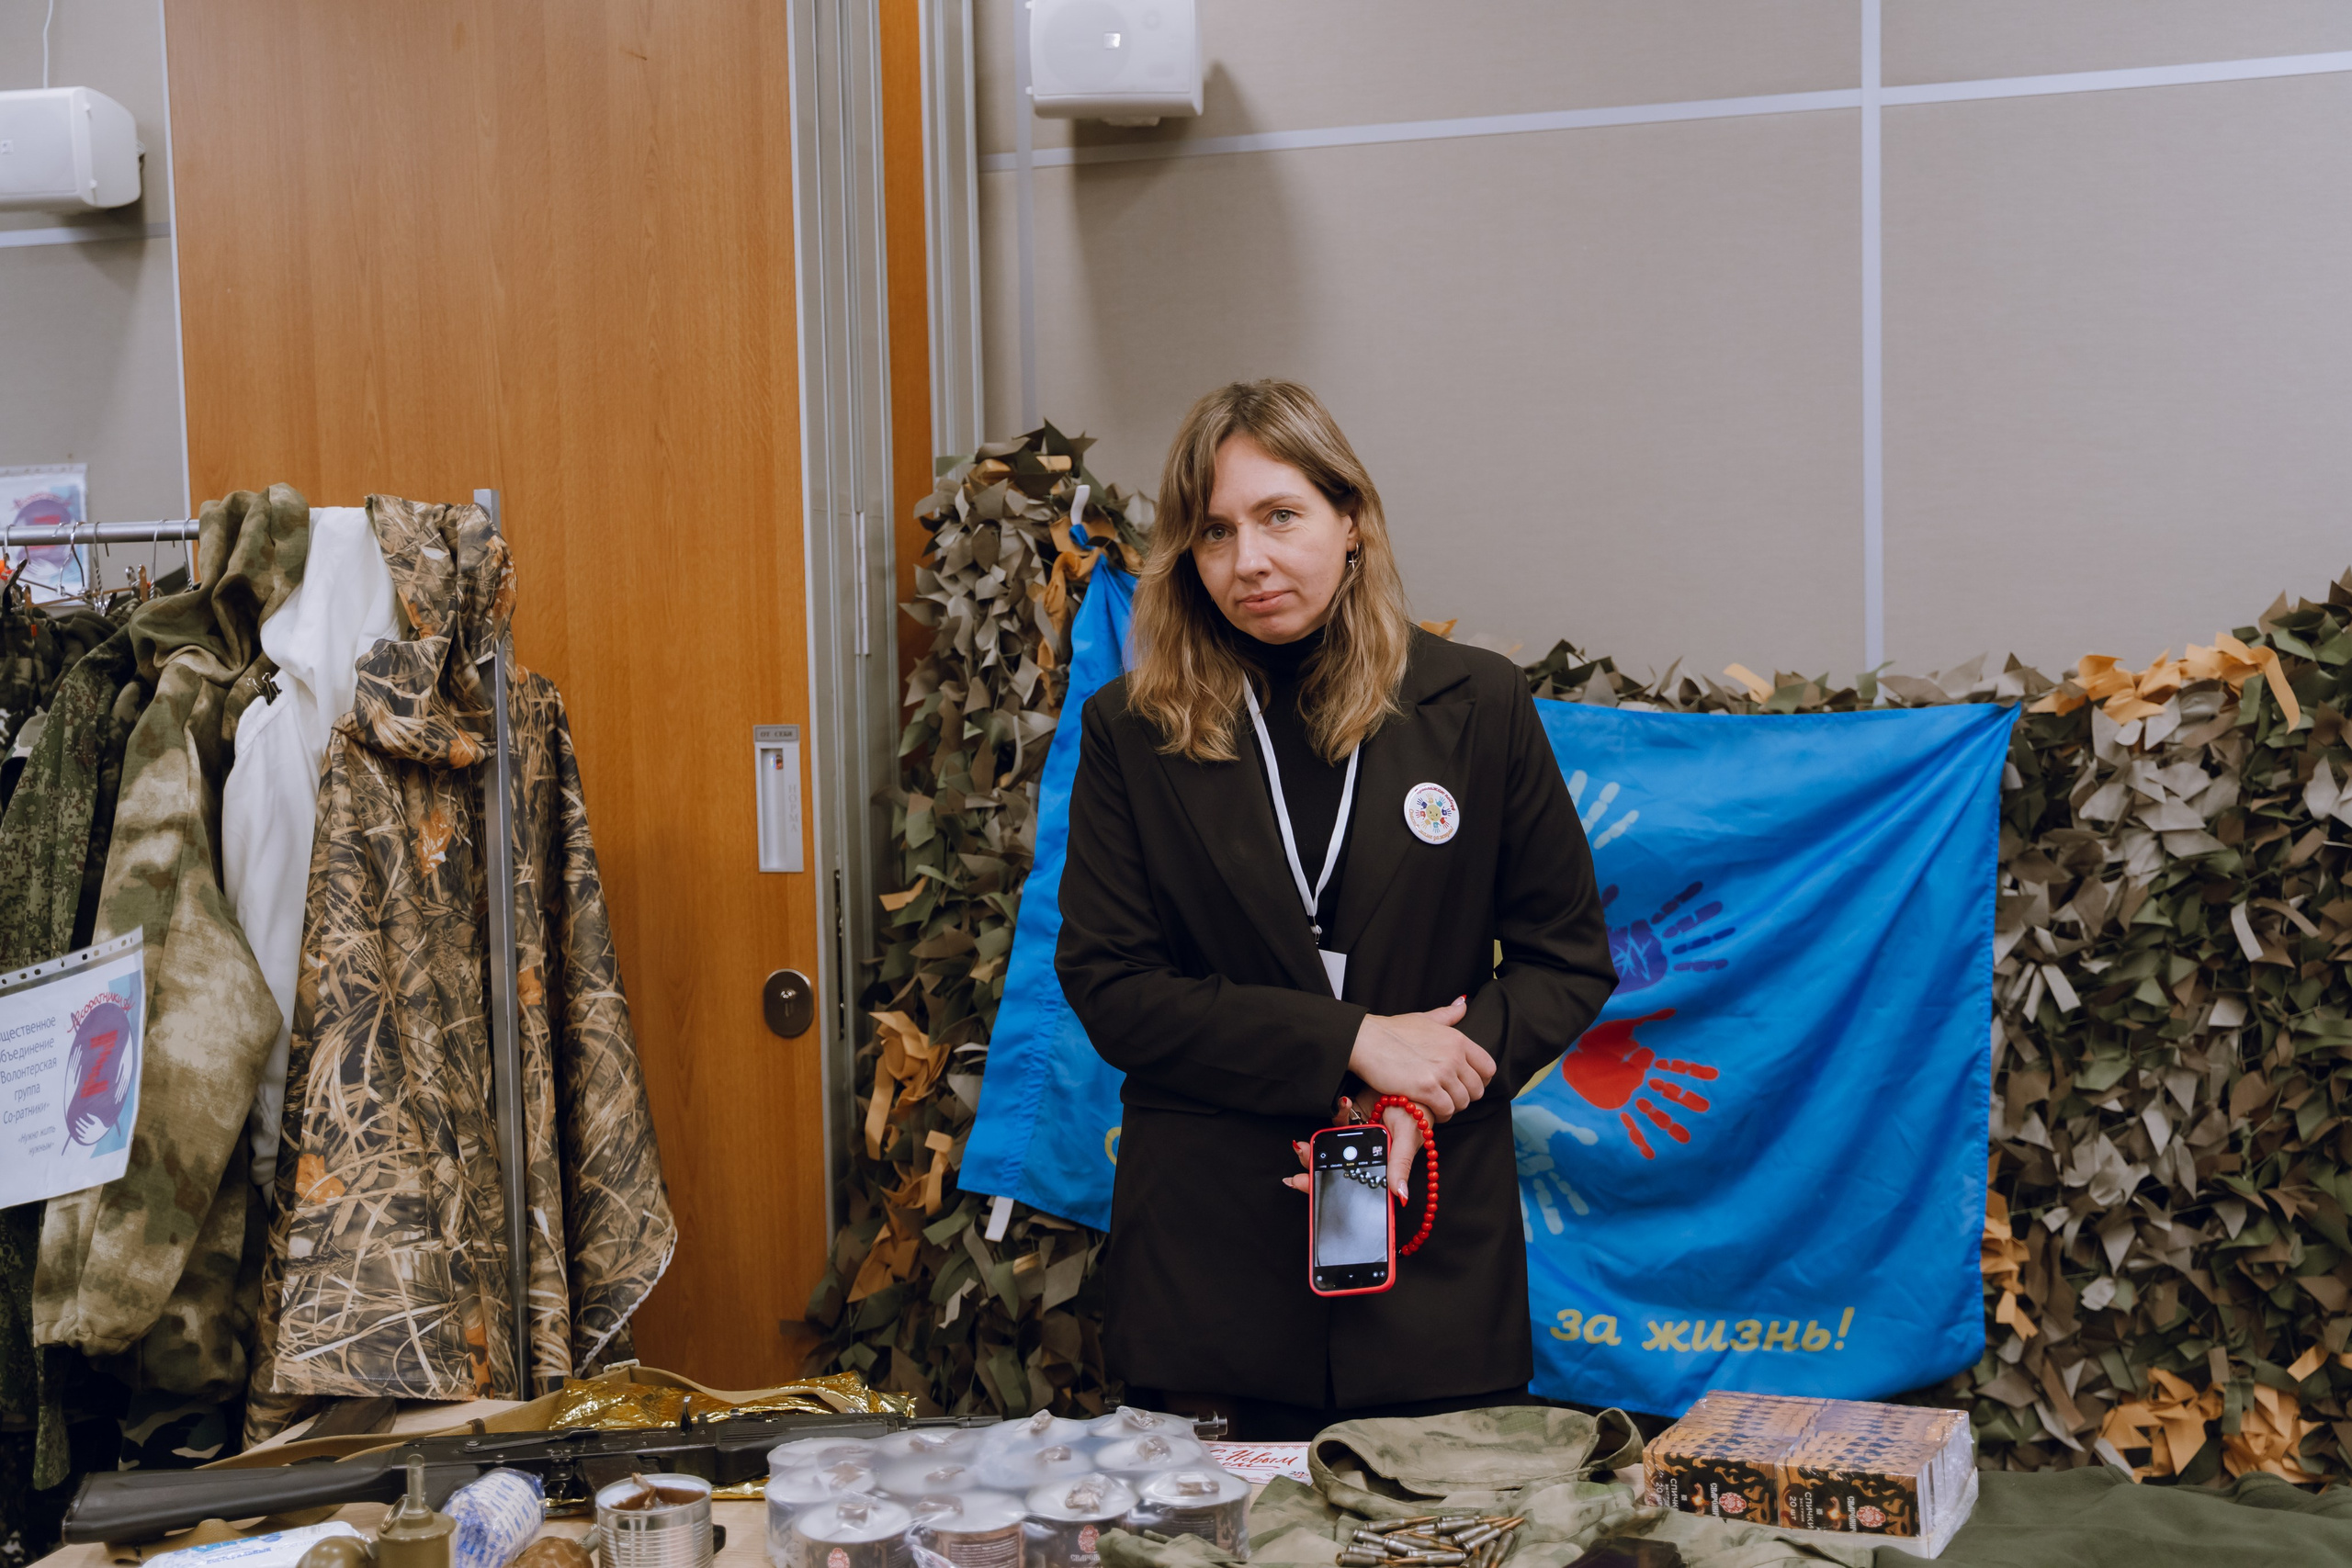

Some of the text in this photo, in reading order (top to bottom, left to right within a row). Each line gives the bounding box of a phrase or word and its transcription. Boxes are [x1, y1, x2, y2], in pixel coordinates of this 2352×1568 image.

[0, 1016, 56, 1043] щественное
[0, 1038, 55, 1063] бъединение
[14, 1083, 40, 1102] группа
[1549, 1306, 1856, 1353] за жизнь!
[1656, 1482, 1664, 1494] 20
[1670, 1478, 1679, 1508] СПИЧК
[1789, 1495, 1797, 1507] 20
[1804, 1492, 1815, 1529] СПИЧКИ
